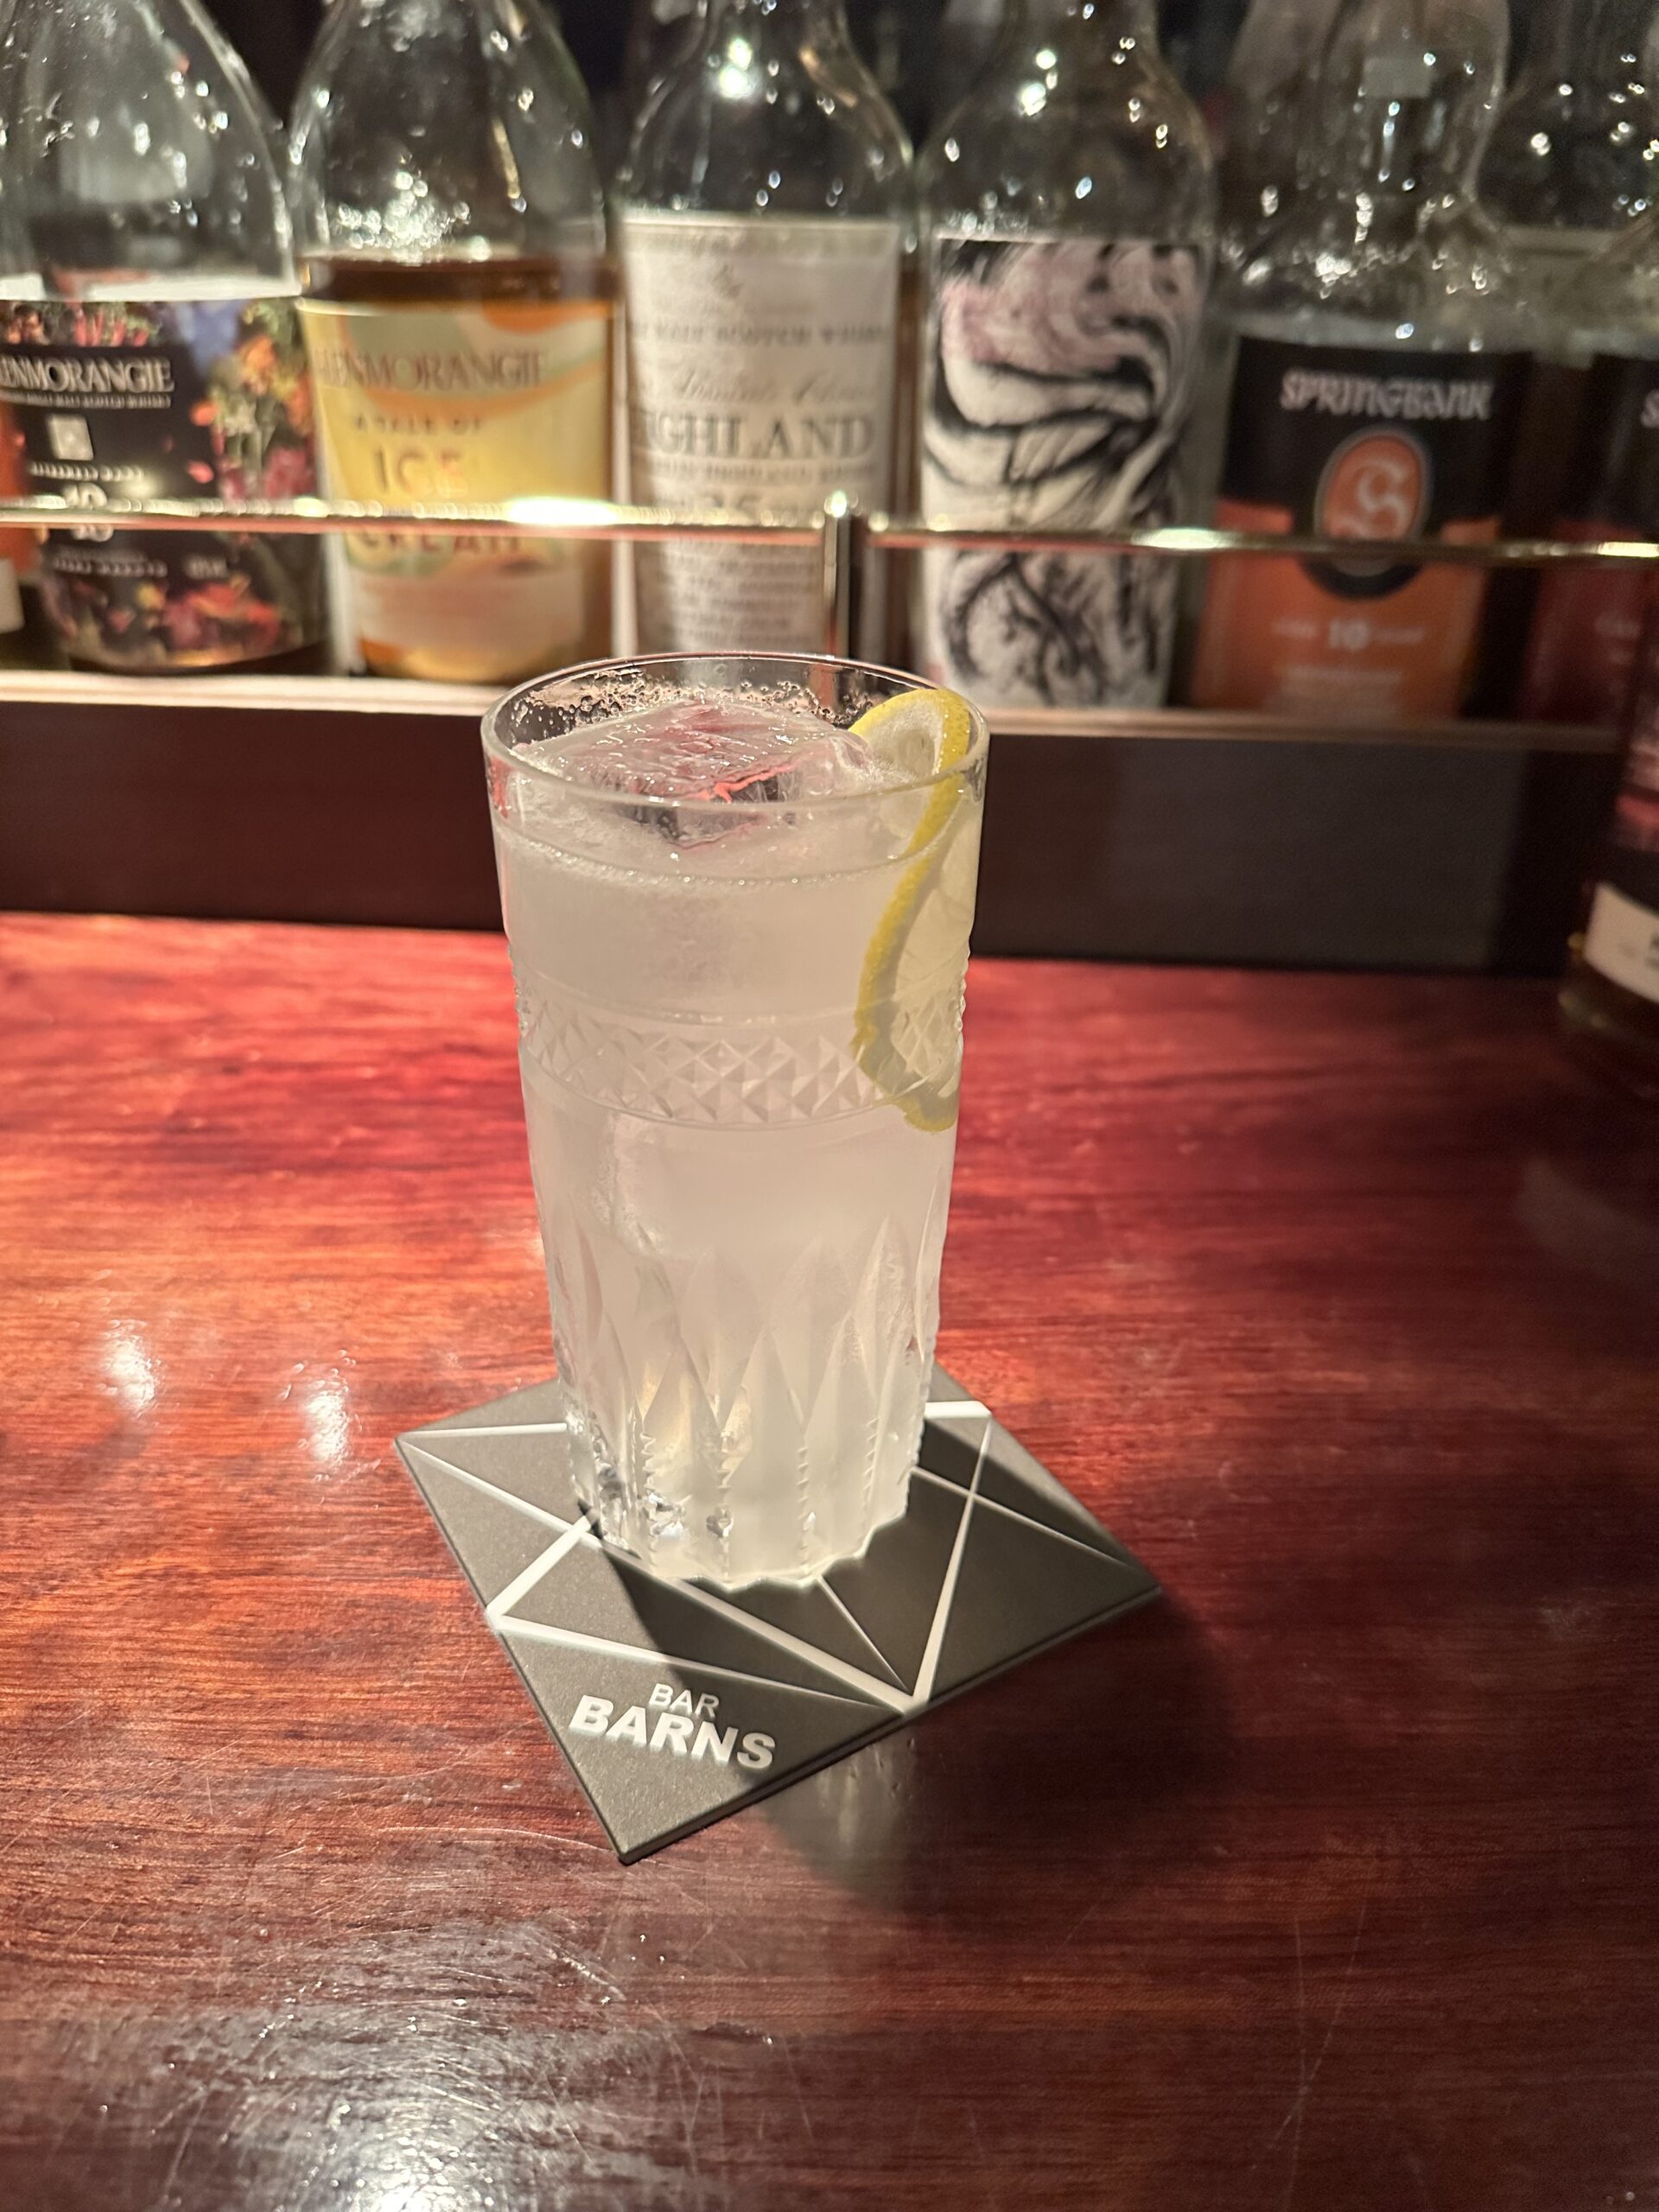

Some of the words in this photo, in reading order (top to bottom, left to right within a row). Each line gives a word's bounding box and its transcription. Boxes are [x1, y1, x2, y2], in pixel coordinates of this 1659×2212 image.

[1280, 368, 1494, 421] SPRINGBANK
[372, 445, 470, 497] ICE
[649, 1682, 720, 1719] BAR
[569, 1694, 776, 1770] BARNS
